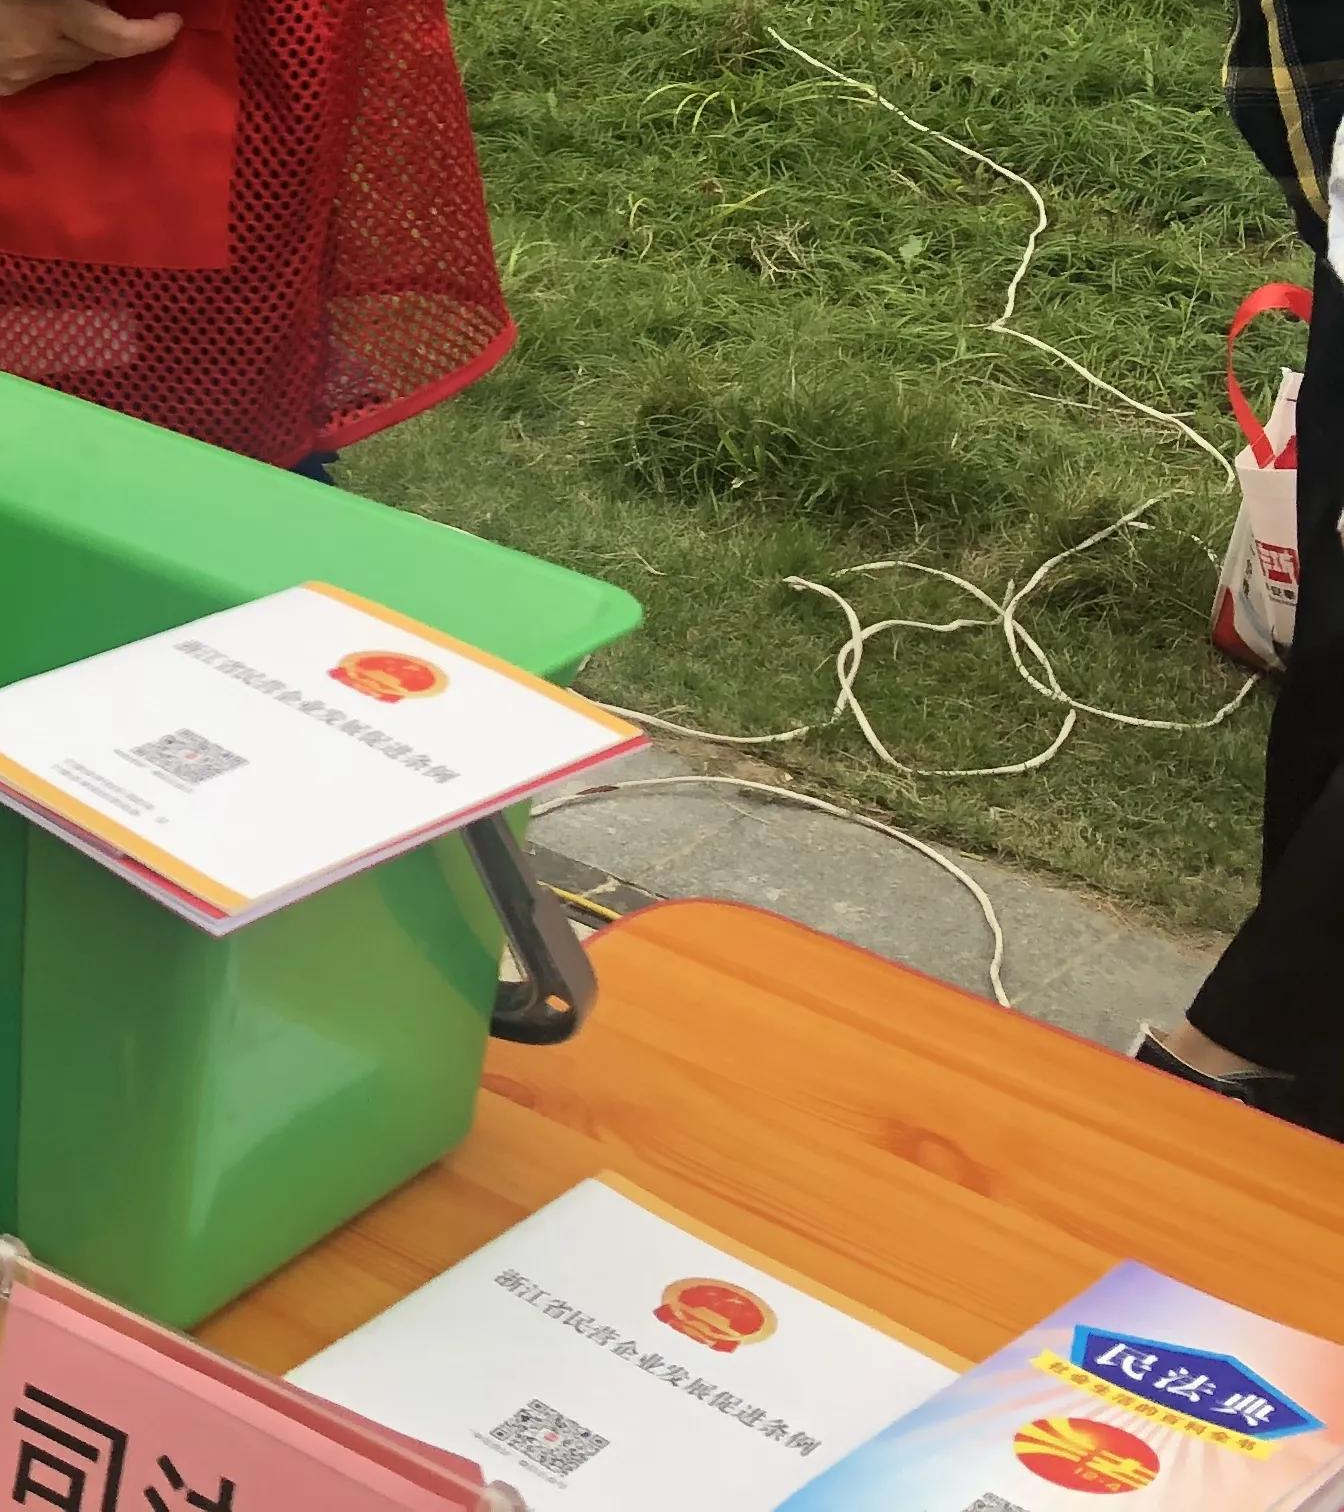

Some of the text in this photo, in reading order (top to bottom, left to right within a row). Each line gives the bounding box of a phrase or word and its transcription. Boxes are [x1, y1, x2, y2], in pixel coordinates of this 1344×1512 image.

[493, 1268, 822, 1457] 浙江省民营企业发展促进条例
[1094, 1342, 1276, 1427] 民法典
